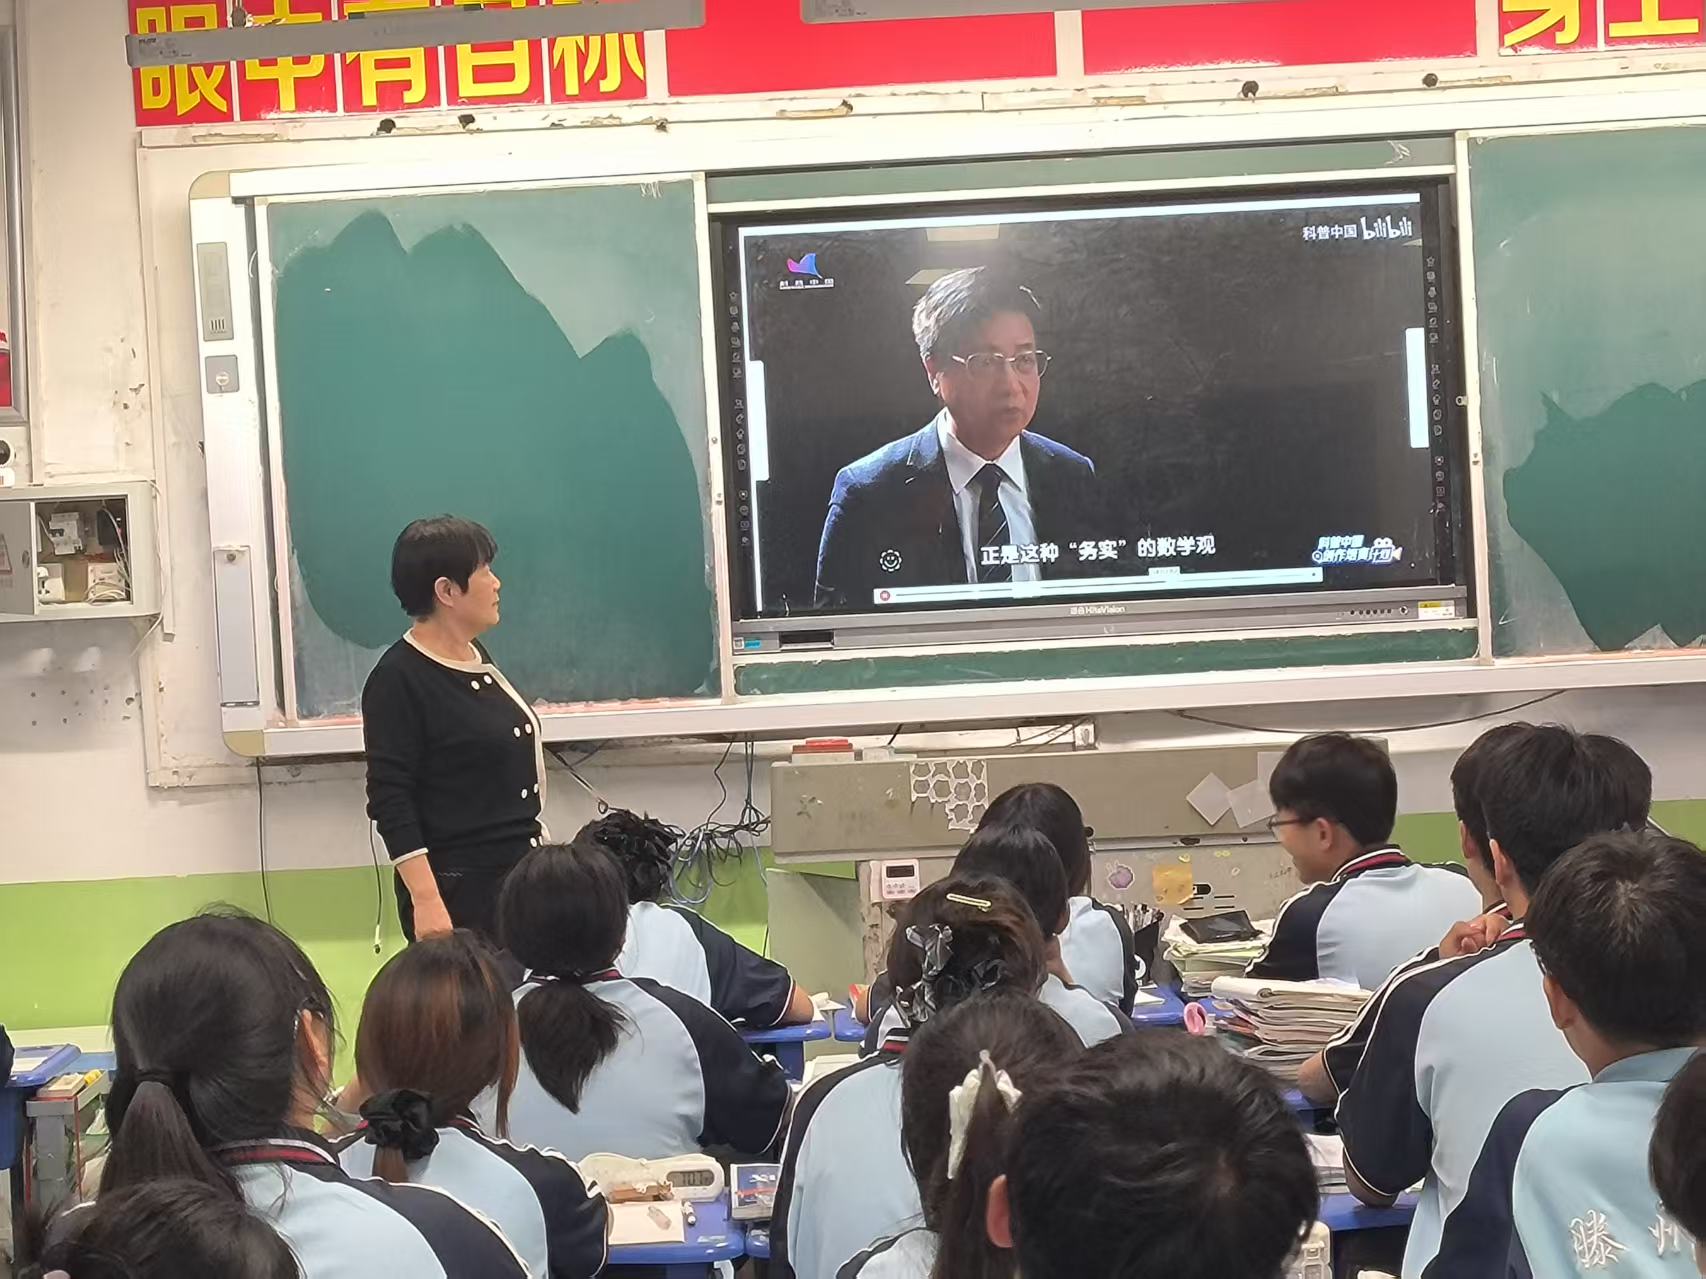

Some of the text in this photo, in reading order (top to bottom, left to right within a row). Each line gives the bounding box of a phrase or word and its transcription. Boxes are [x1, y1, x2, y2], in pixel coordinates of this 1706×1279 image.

[1302, 215, 1413, 241] 科普中国 bilibili
